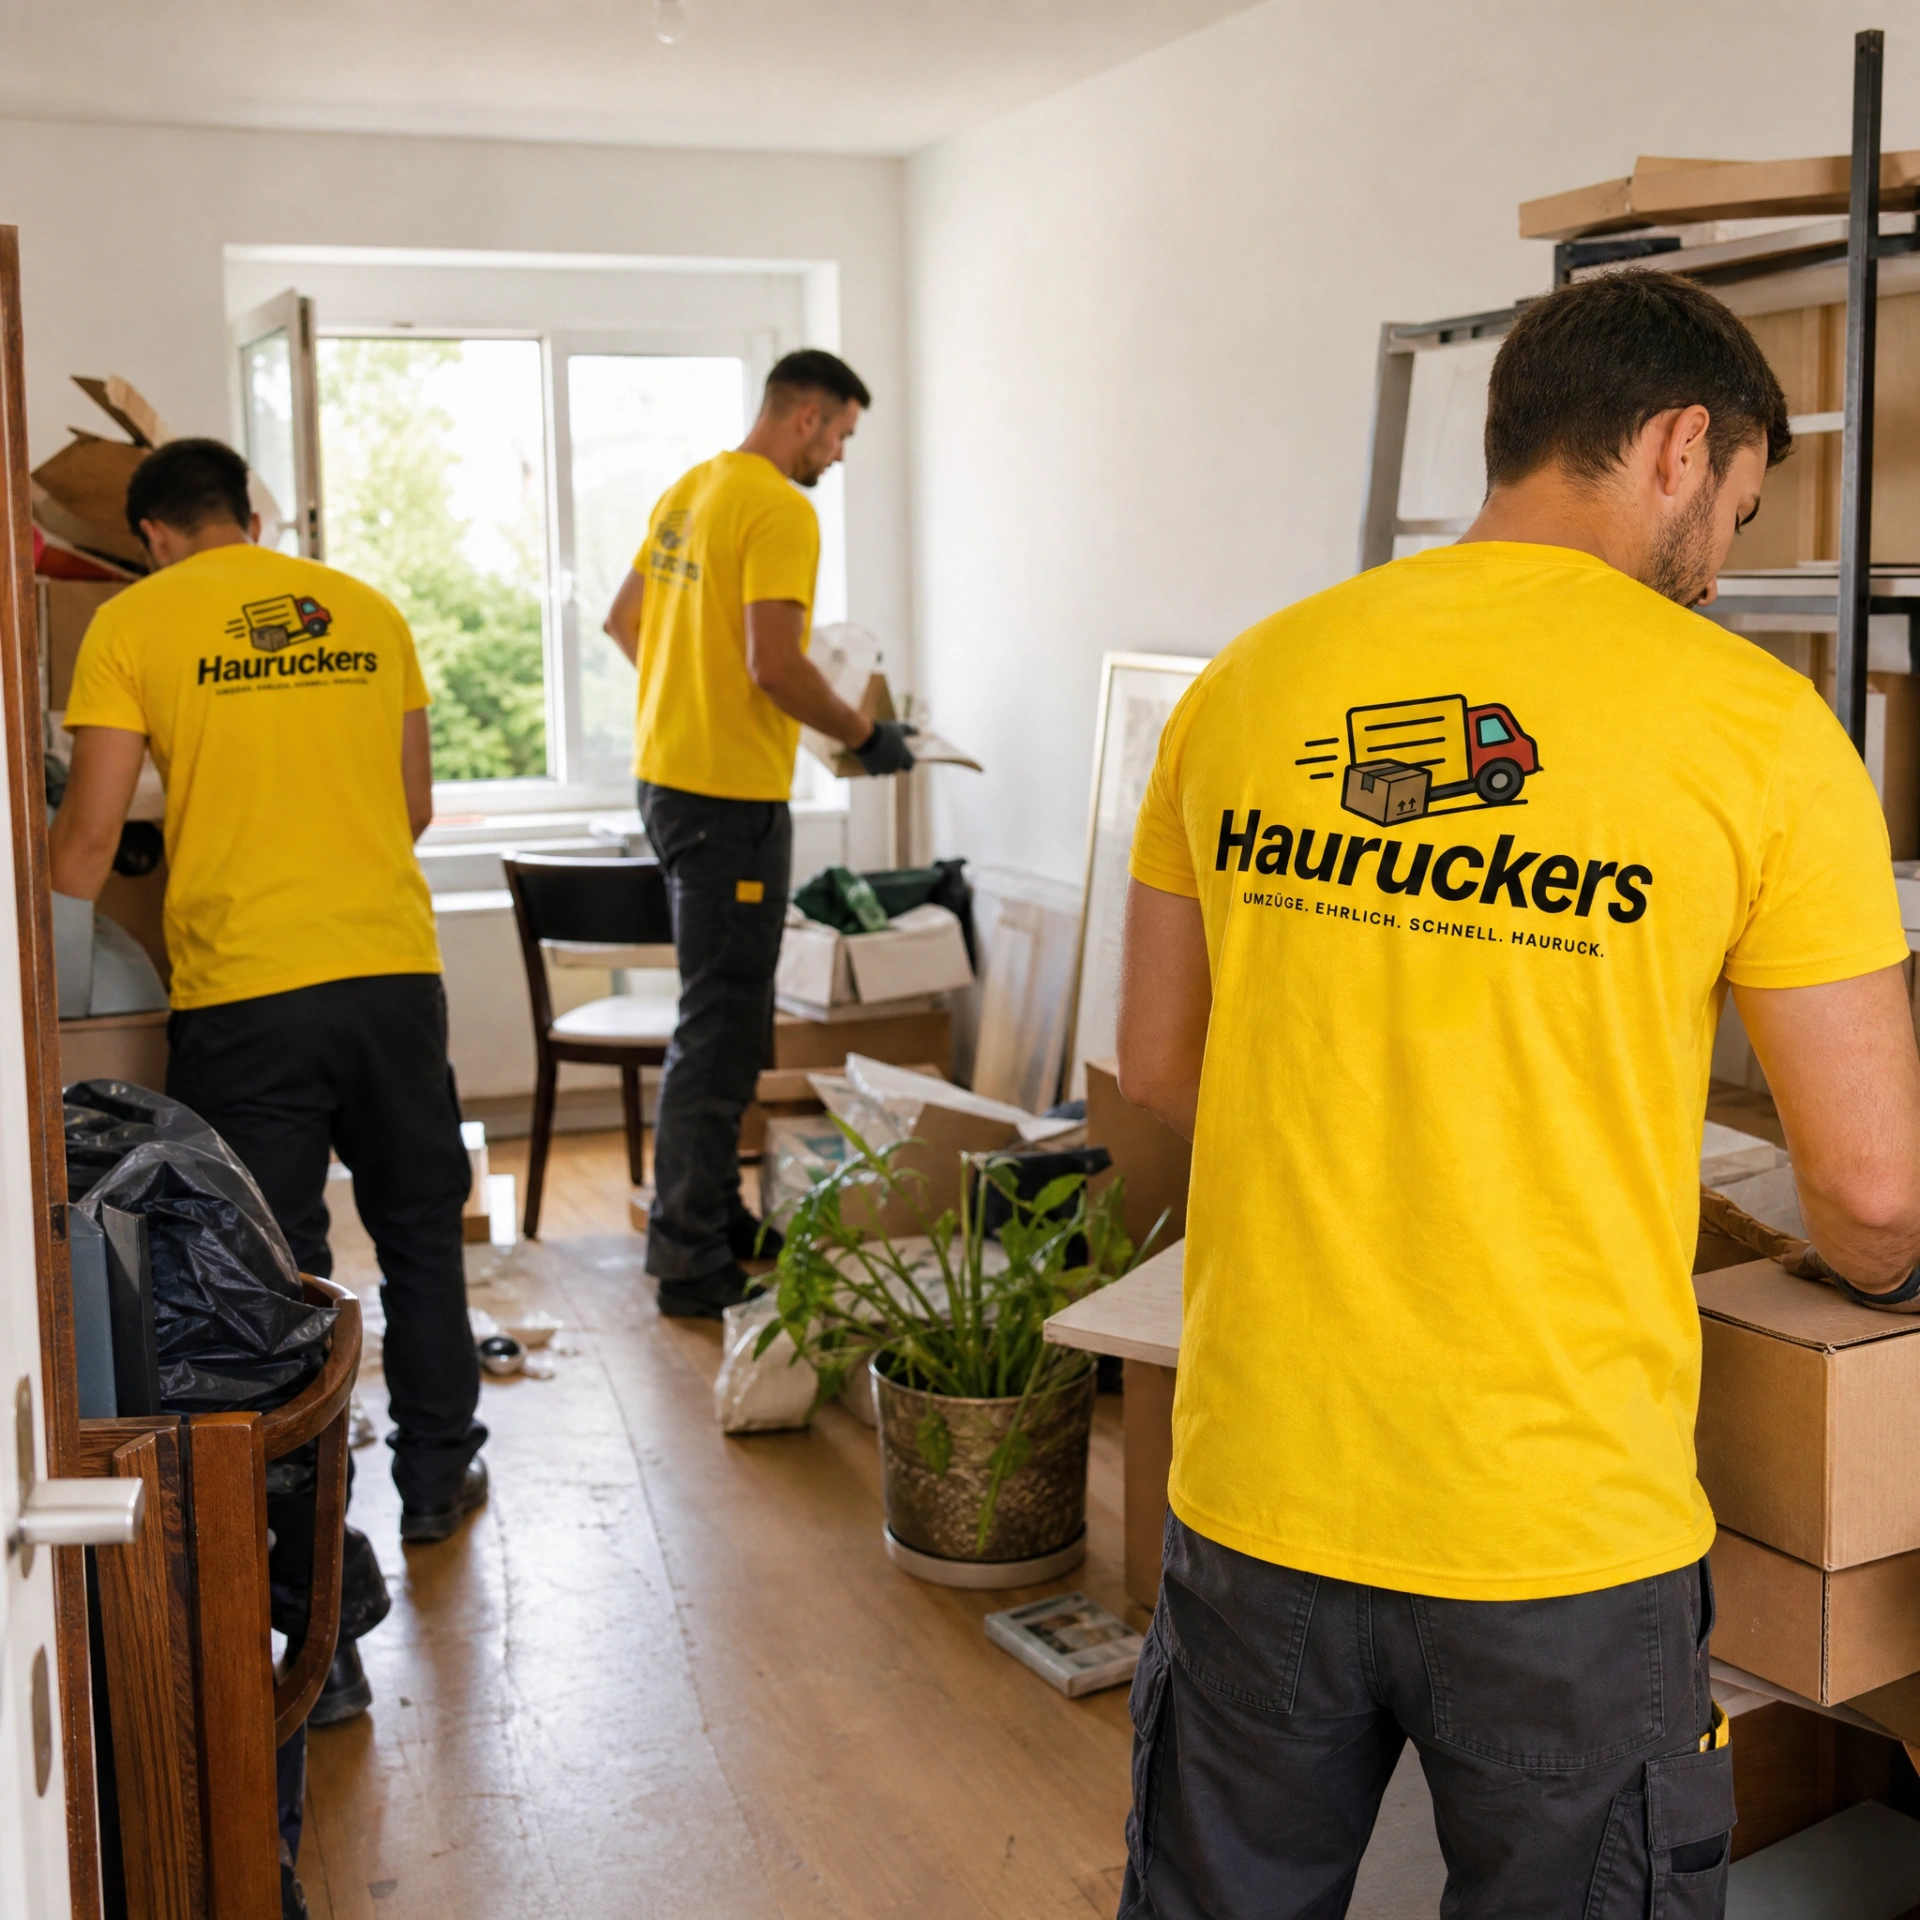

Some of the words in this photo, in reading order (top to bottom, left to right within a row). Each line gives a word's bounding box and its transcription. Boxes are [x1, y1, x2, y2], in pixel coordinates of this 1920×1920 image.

[197, 646, 378, 685] Hauruckers
[1214, 808, 1653, 924] Hauruckers
[1242, 891, 1309, 911] UMZÜGE.
[1315, 901, 1401, 929] EHRLICH.
[1409, 917, 1503, 943] SCHNELL.
[1511, 931, 1604, 958] HAURUCK.
